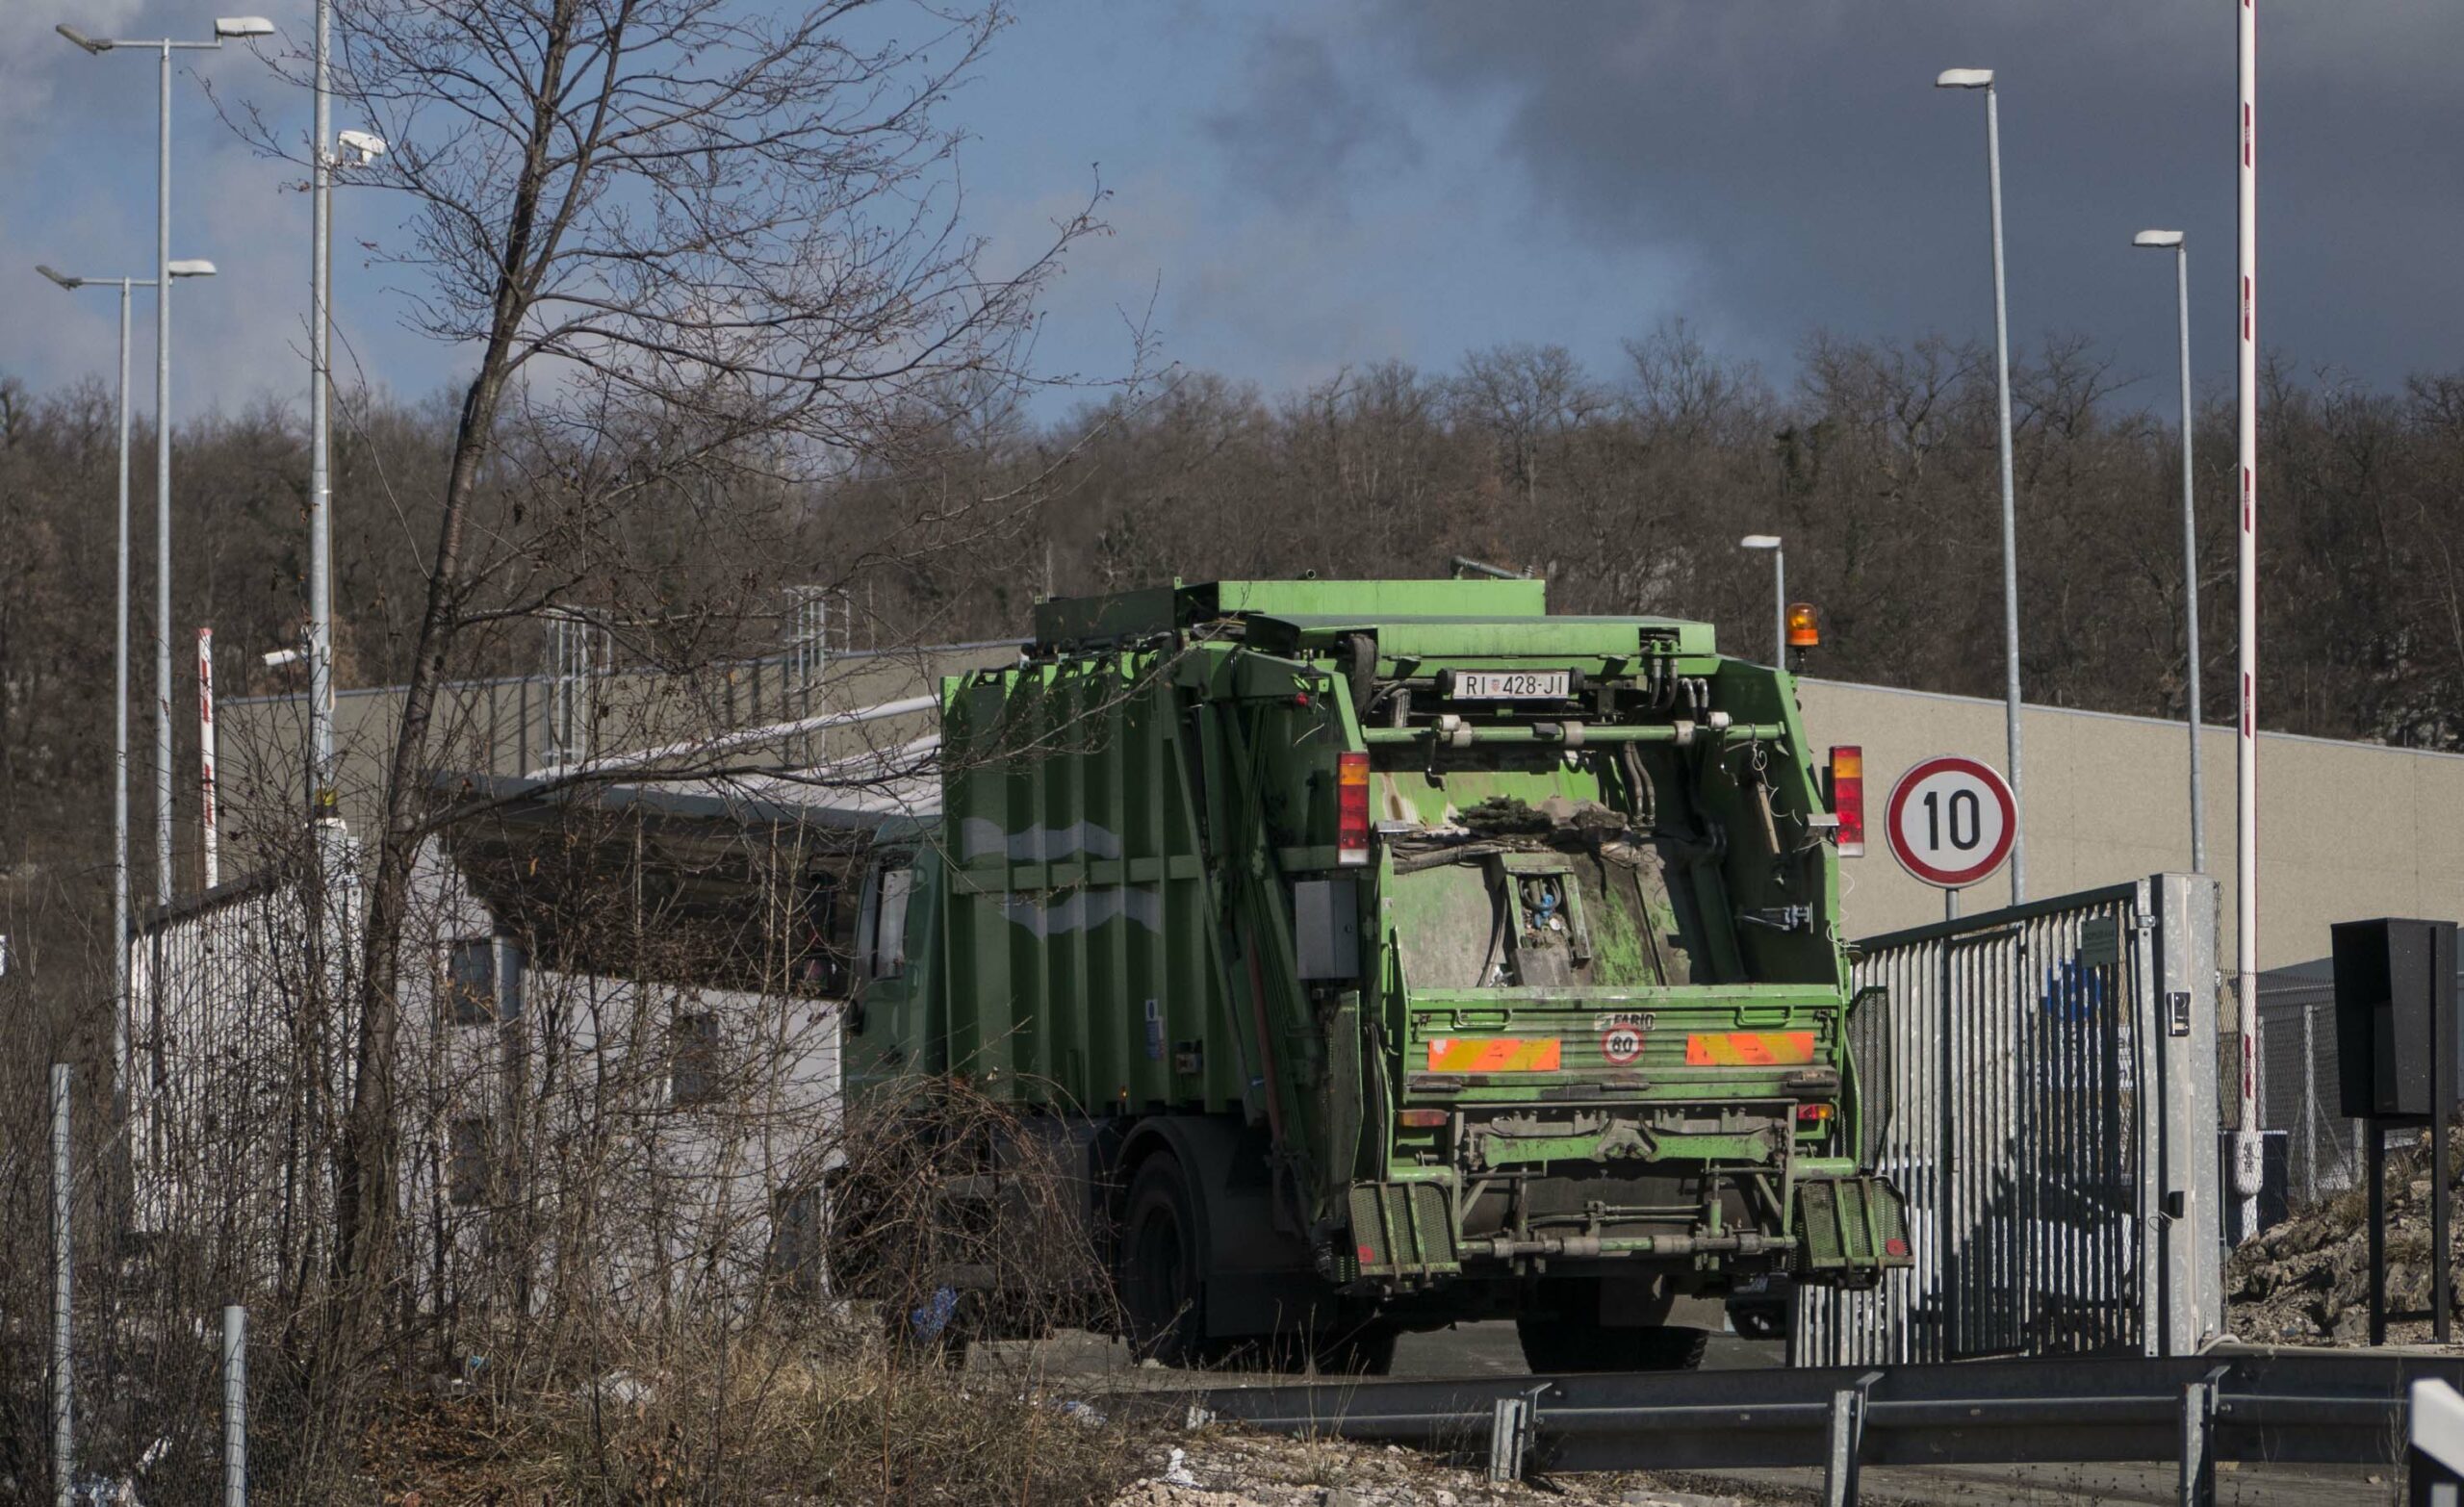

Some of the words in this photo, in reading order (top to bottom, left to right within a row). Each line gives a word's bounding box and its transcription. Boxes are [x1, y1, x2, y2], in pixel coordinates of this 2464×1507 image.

[1466, 677, 1485, 694] RI
[1502, 676, 1562, 695] 428-JI
[1923, 789, 1981, 851] 10
[1611, 1035, 1633, 1053] 80
